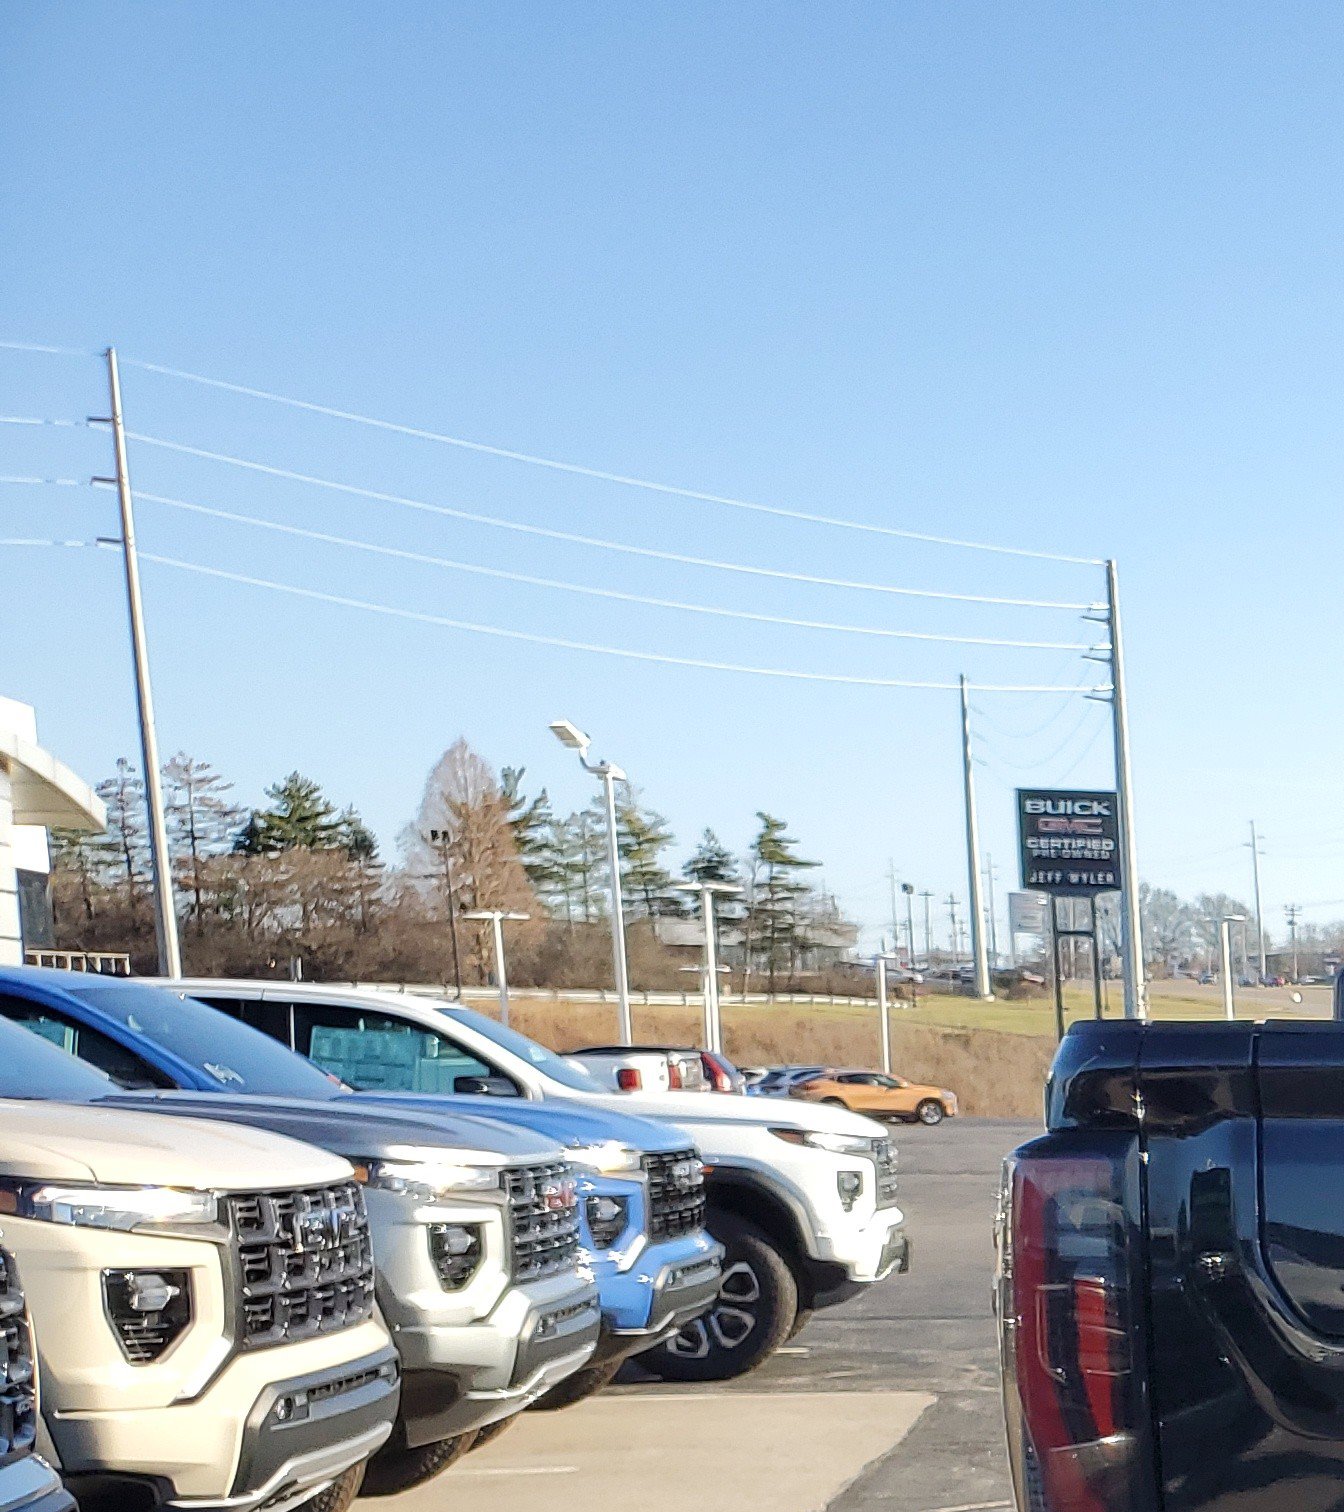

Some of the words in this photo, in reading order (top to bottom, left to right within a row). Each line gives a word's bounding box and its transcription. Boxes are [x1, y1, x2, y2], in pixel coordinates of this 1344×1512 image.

[1024, 798, 1113, 816] BUICK
[1026, 836, 1115, 851] CERTIFIED
[1029, 869, 1062, 884] JEFF
